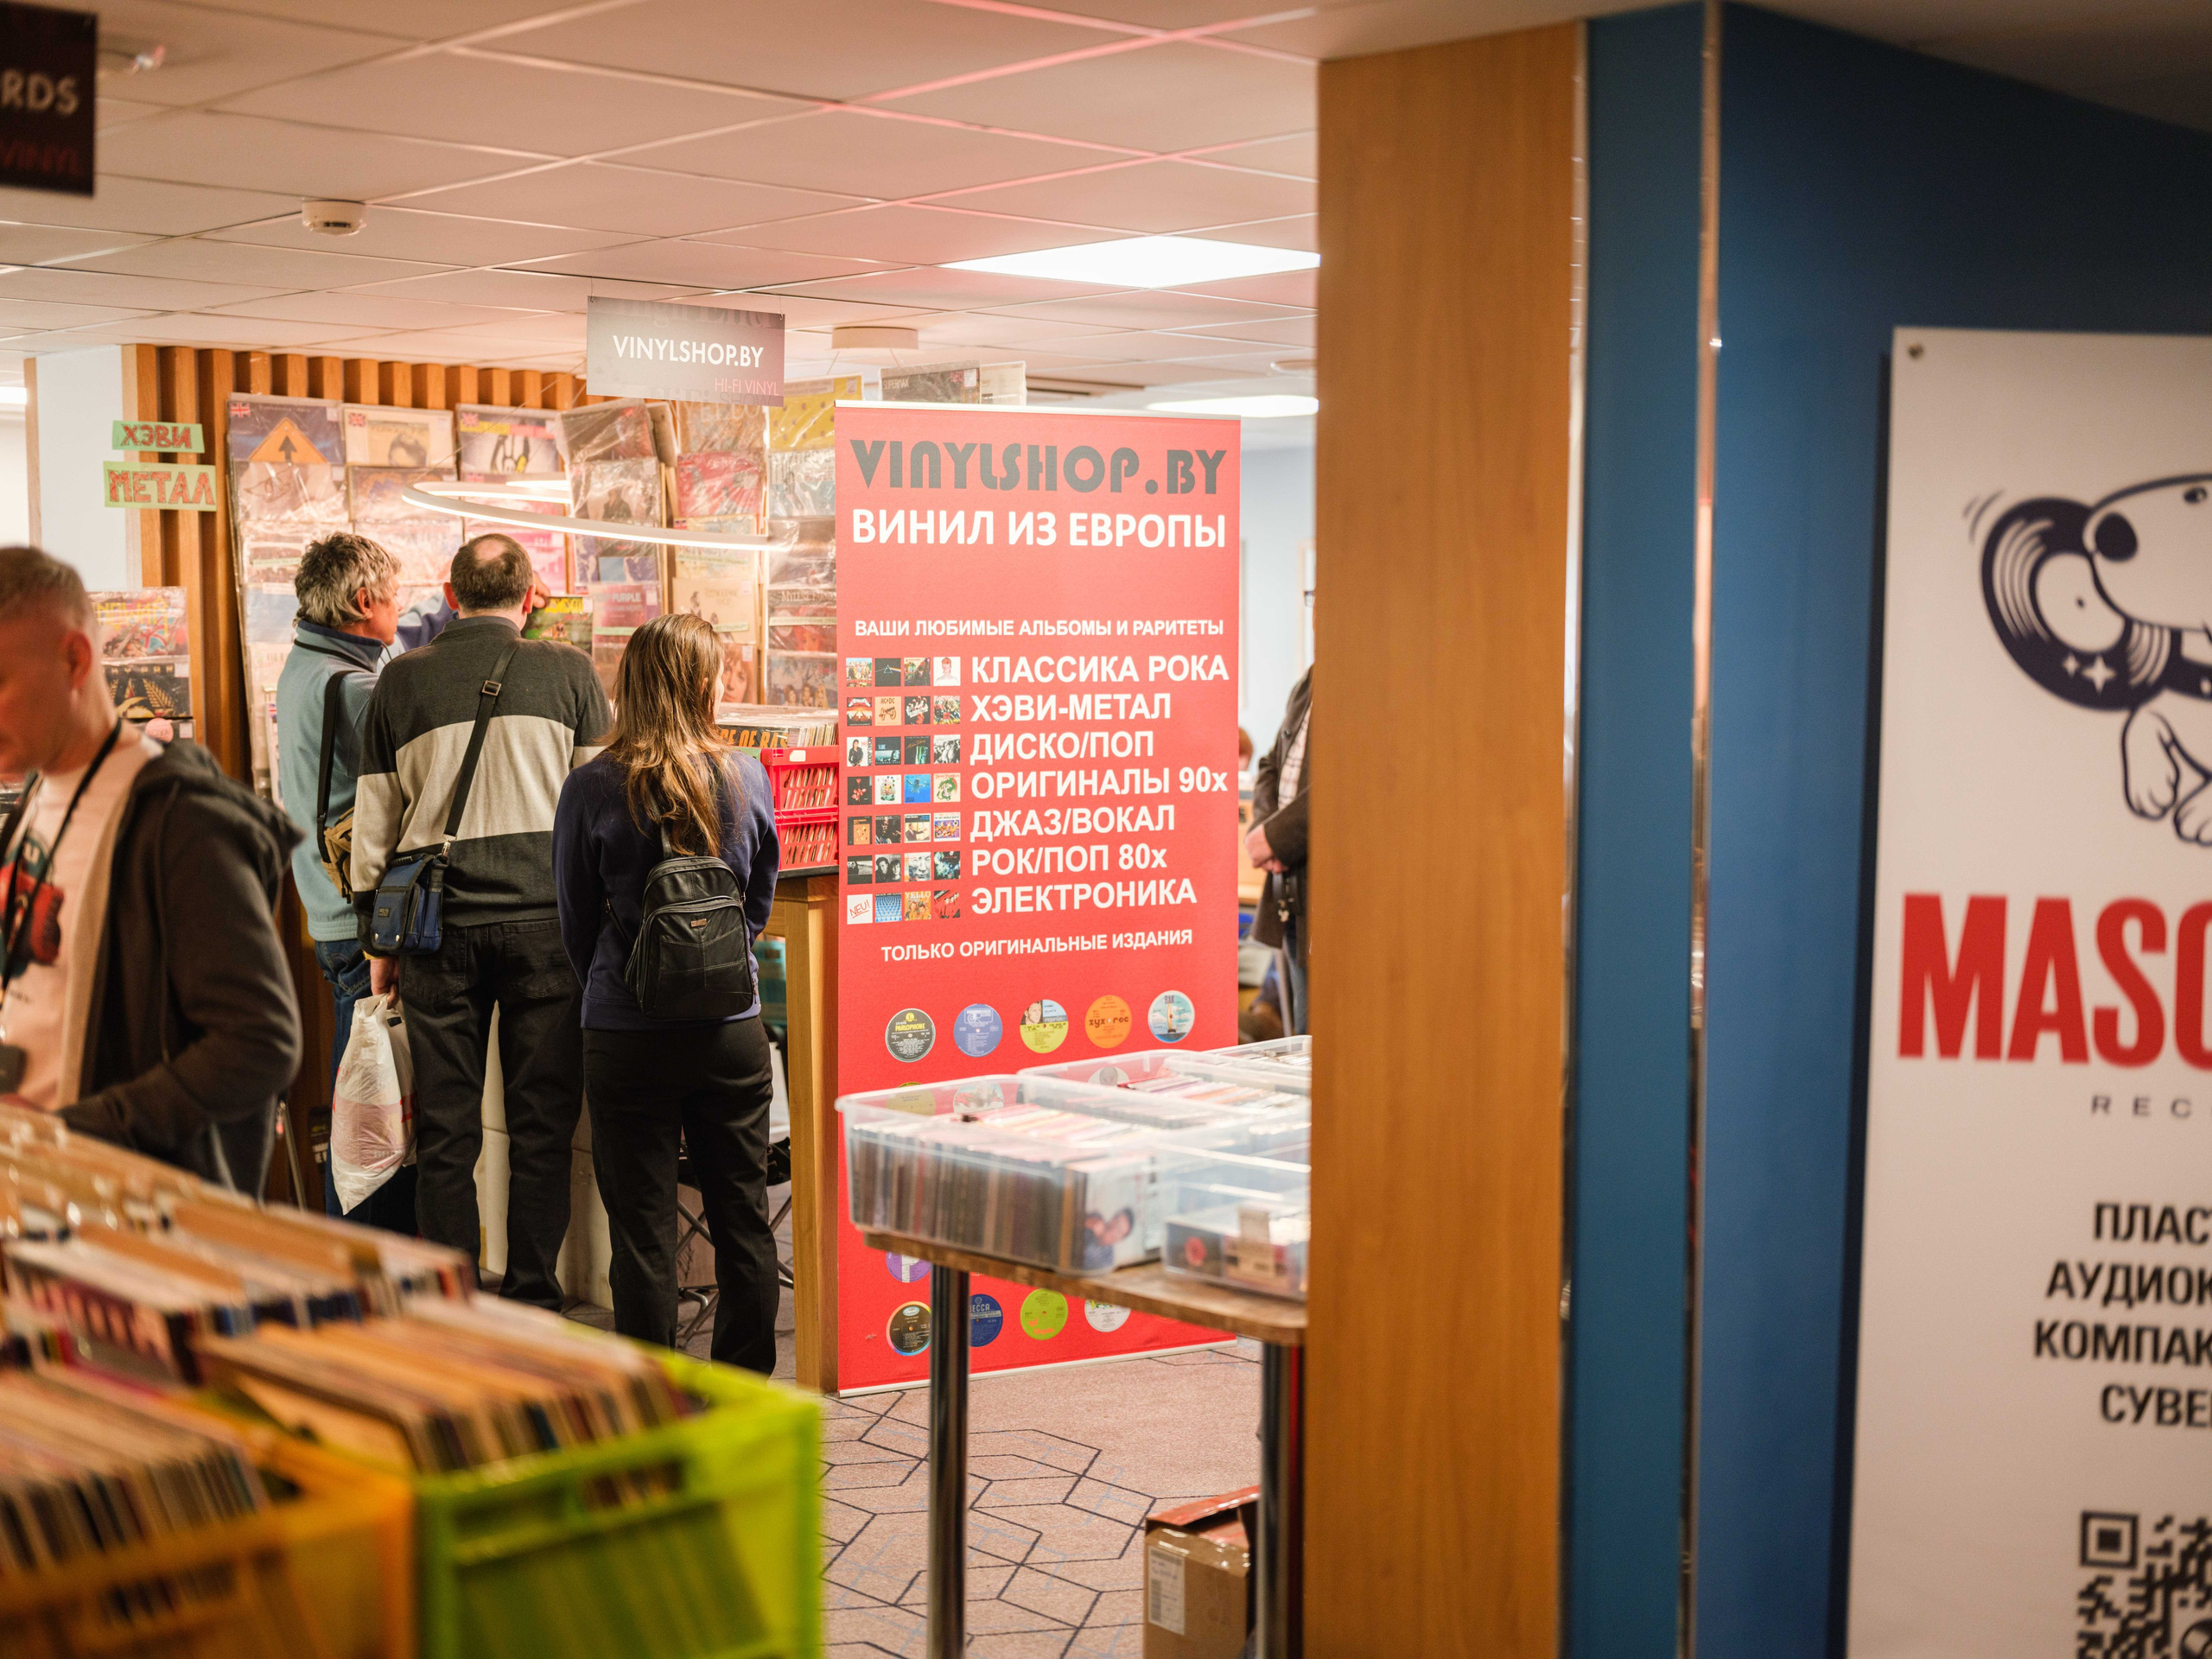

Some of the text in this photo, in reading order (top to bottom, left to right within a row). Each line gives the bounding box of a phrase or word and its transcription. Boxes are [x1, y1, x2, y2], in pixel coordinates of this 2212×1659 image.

[613, 335, 764, 368] VINYLSHOP.BY
[715, 378, 741, 393] HI-FI
[745, 379, 779, 397] VINYL
[121, 424, 192, 448] ХЭВИ
[849, 439, 1227, 495] VINYLSHOP.BY
[108, 469, 216, 505] МЕТАЛ
[853, 509, 1225, 548] ВИНИЛ ИЗ ЕВРОПЫ
[855, 620, 910, 636] ВАШИ
[914, 620, 1014, 636] ЛЮБИМЫЕ
[1019, 620, 1112, 636] АЛЬБОМЫ
[1116, 620, 1128, 636] И
[1133, 620, 1224, 635] РАРИТЕТЫ
[971, 654, 1230, 683] КЛАССИКА РОКА
[970, 692, 1171, 722] ХЭВИ-МЕТАЛ
[760, 732, 790, 748] BAS
[970, 731, 1154, 765] ДИСКО/ПОП
[971, 768, 1169, 799] ОРИГИНАЛЫ
[970, 804, 1175, 842] ДЖАЗ/ВОКАЛ
[971, 845, 1109, 876] РОК/ПОП
[849, 899, 869, 917] NEU!
[905, 891, 931, 899] YELLO
[971, 878, 1198, 914] ЭЛЕКТРОНИКА
[881, 929, 1193, 962] ТОЛЬКО ОРИГИНАЛЬНЫЕ ИЗДАНИЯ
[895, 1023, 925, 1032] PARLOPHONE
[2094, 1203, 2212, 1244] ПЛАС
